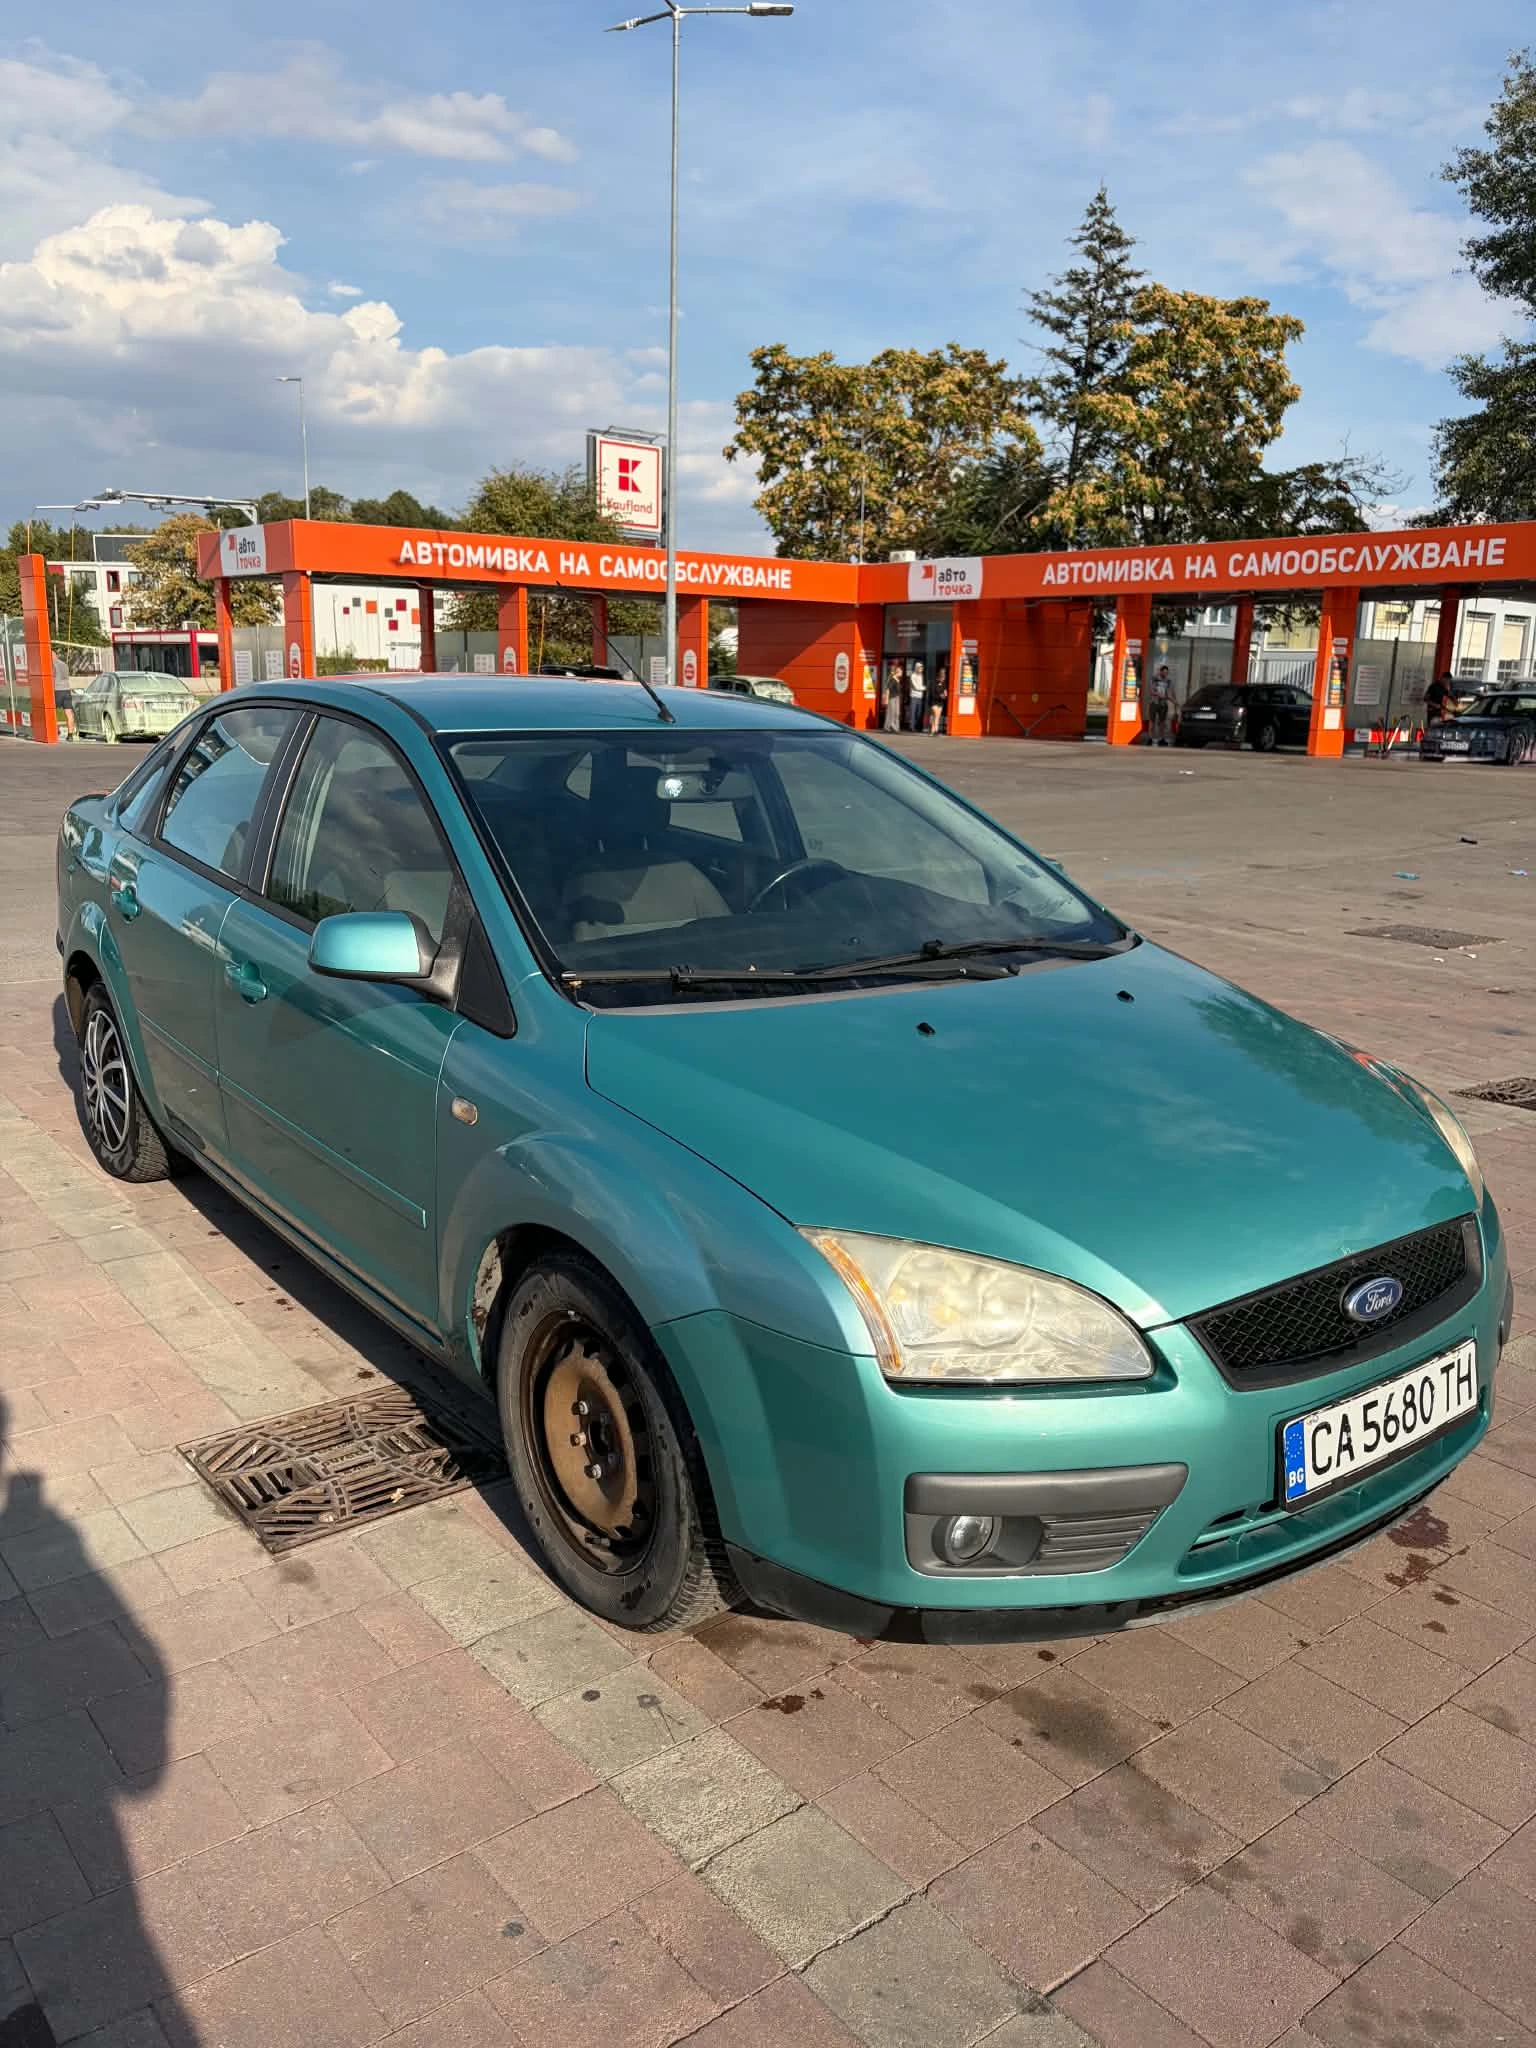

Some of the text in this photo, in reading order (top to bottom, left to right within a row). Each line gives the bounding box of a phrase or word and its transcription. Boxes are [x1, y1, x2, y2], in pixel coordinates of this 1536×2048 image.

[606, 496, 653, 514] Kaufland
[400, 540, 550, 573] АВТОМИВКА
[559, 552, 591, 576] НА
[1042, 538, 1507, 585] АВТОМИВКА НА САМООБСЛУЖВАНЕ
[938, 584, 973, 596] точка
[1365, 1286, 1393, 1313] Ford
[1310, 1352, 1474, 1476] CA 5680 TH
[1289, 1467, 1305, 1488] BG
